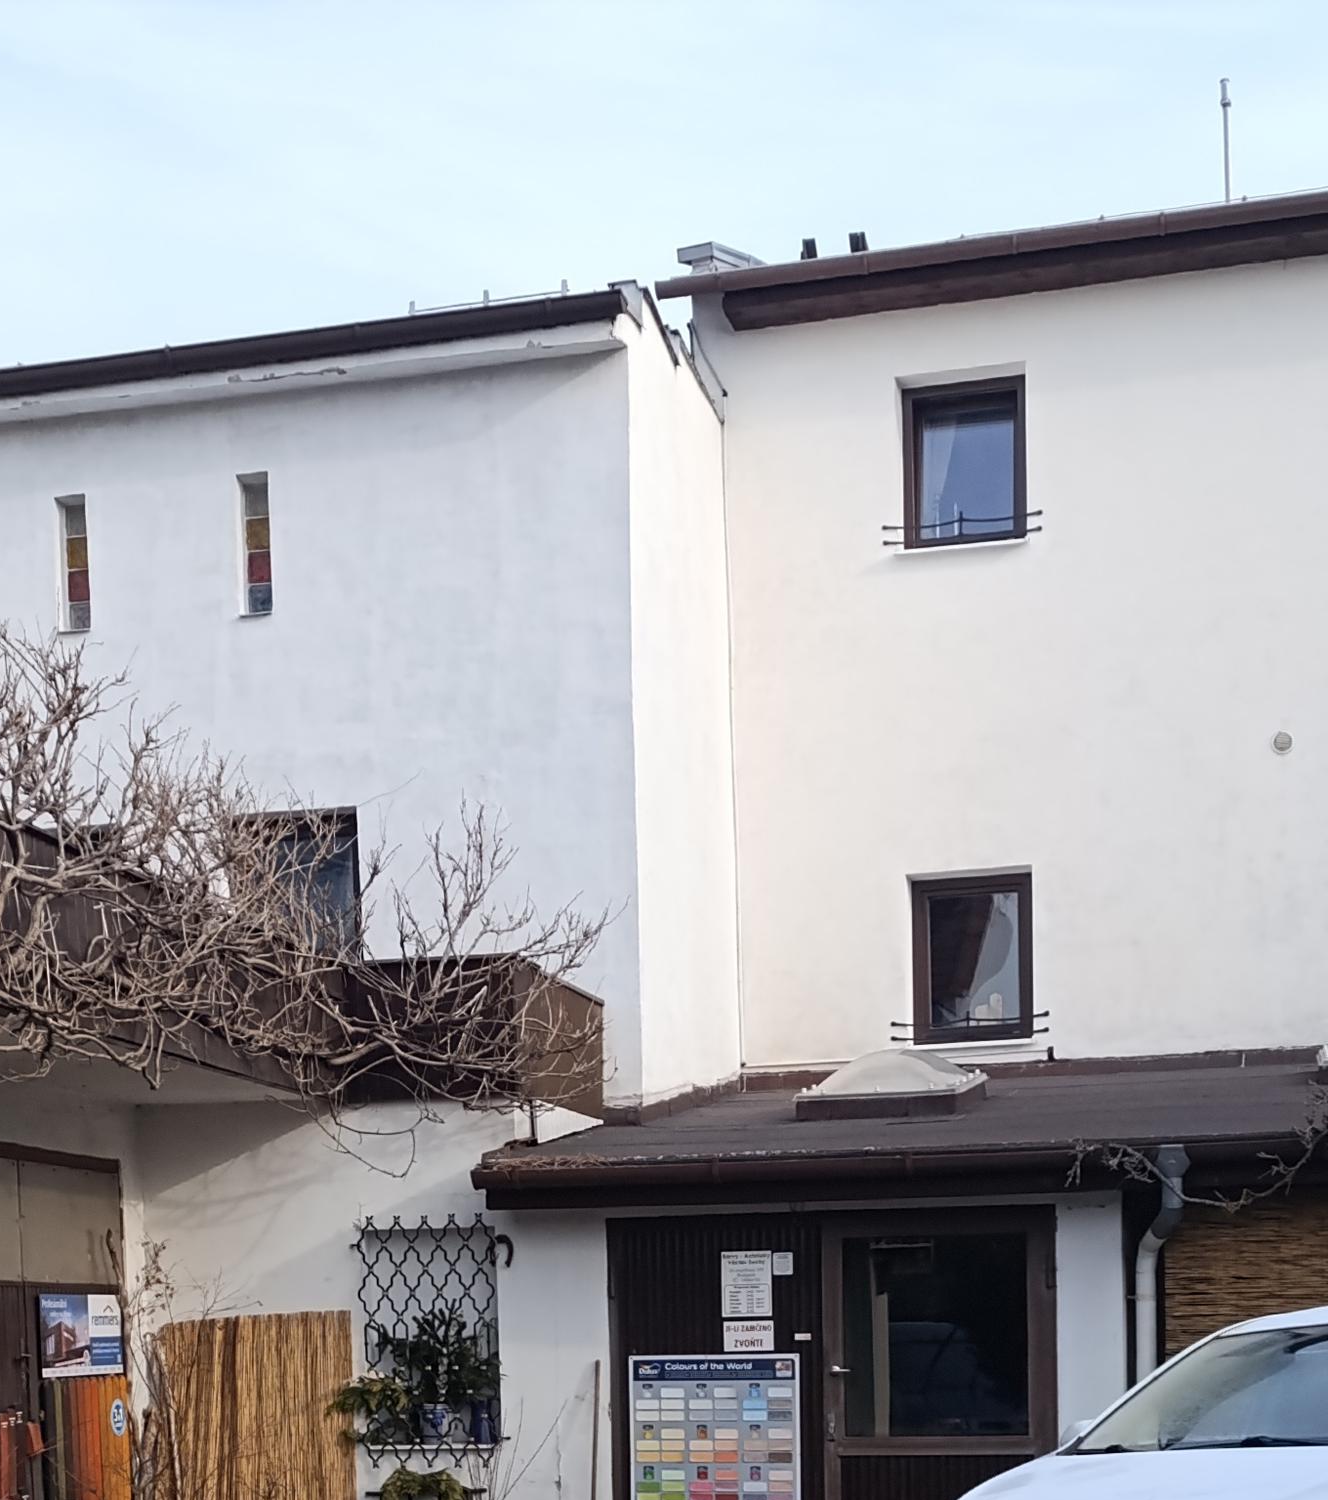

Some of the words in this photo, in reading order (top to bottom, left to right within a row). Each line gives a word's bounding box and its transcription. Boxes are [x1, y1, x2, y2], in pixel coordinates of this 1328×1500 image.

[92, 1315, 119, 1326] remmers
[638, 1367, 658, 1375] Dulux
[665, 1362, 697, 1371] Colours
[699, 1362, 708, 1370] of
[710, 1362, 724, 1370] the
[727, 1362, 753, 1370] World
